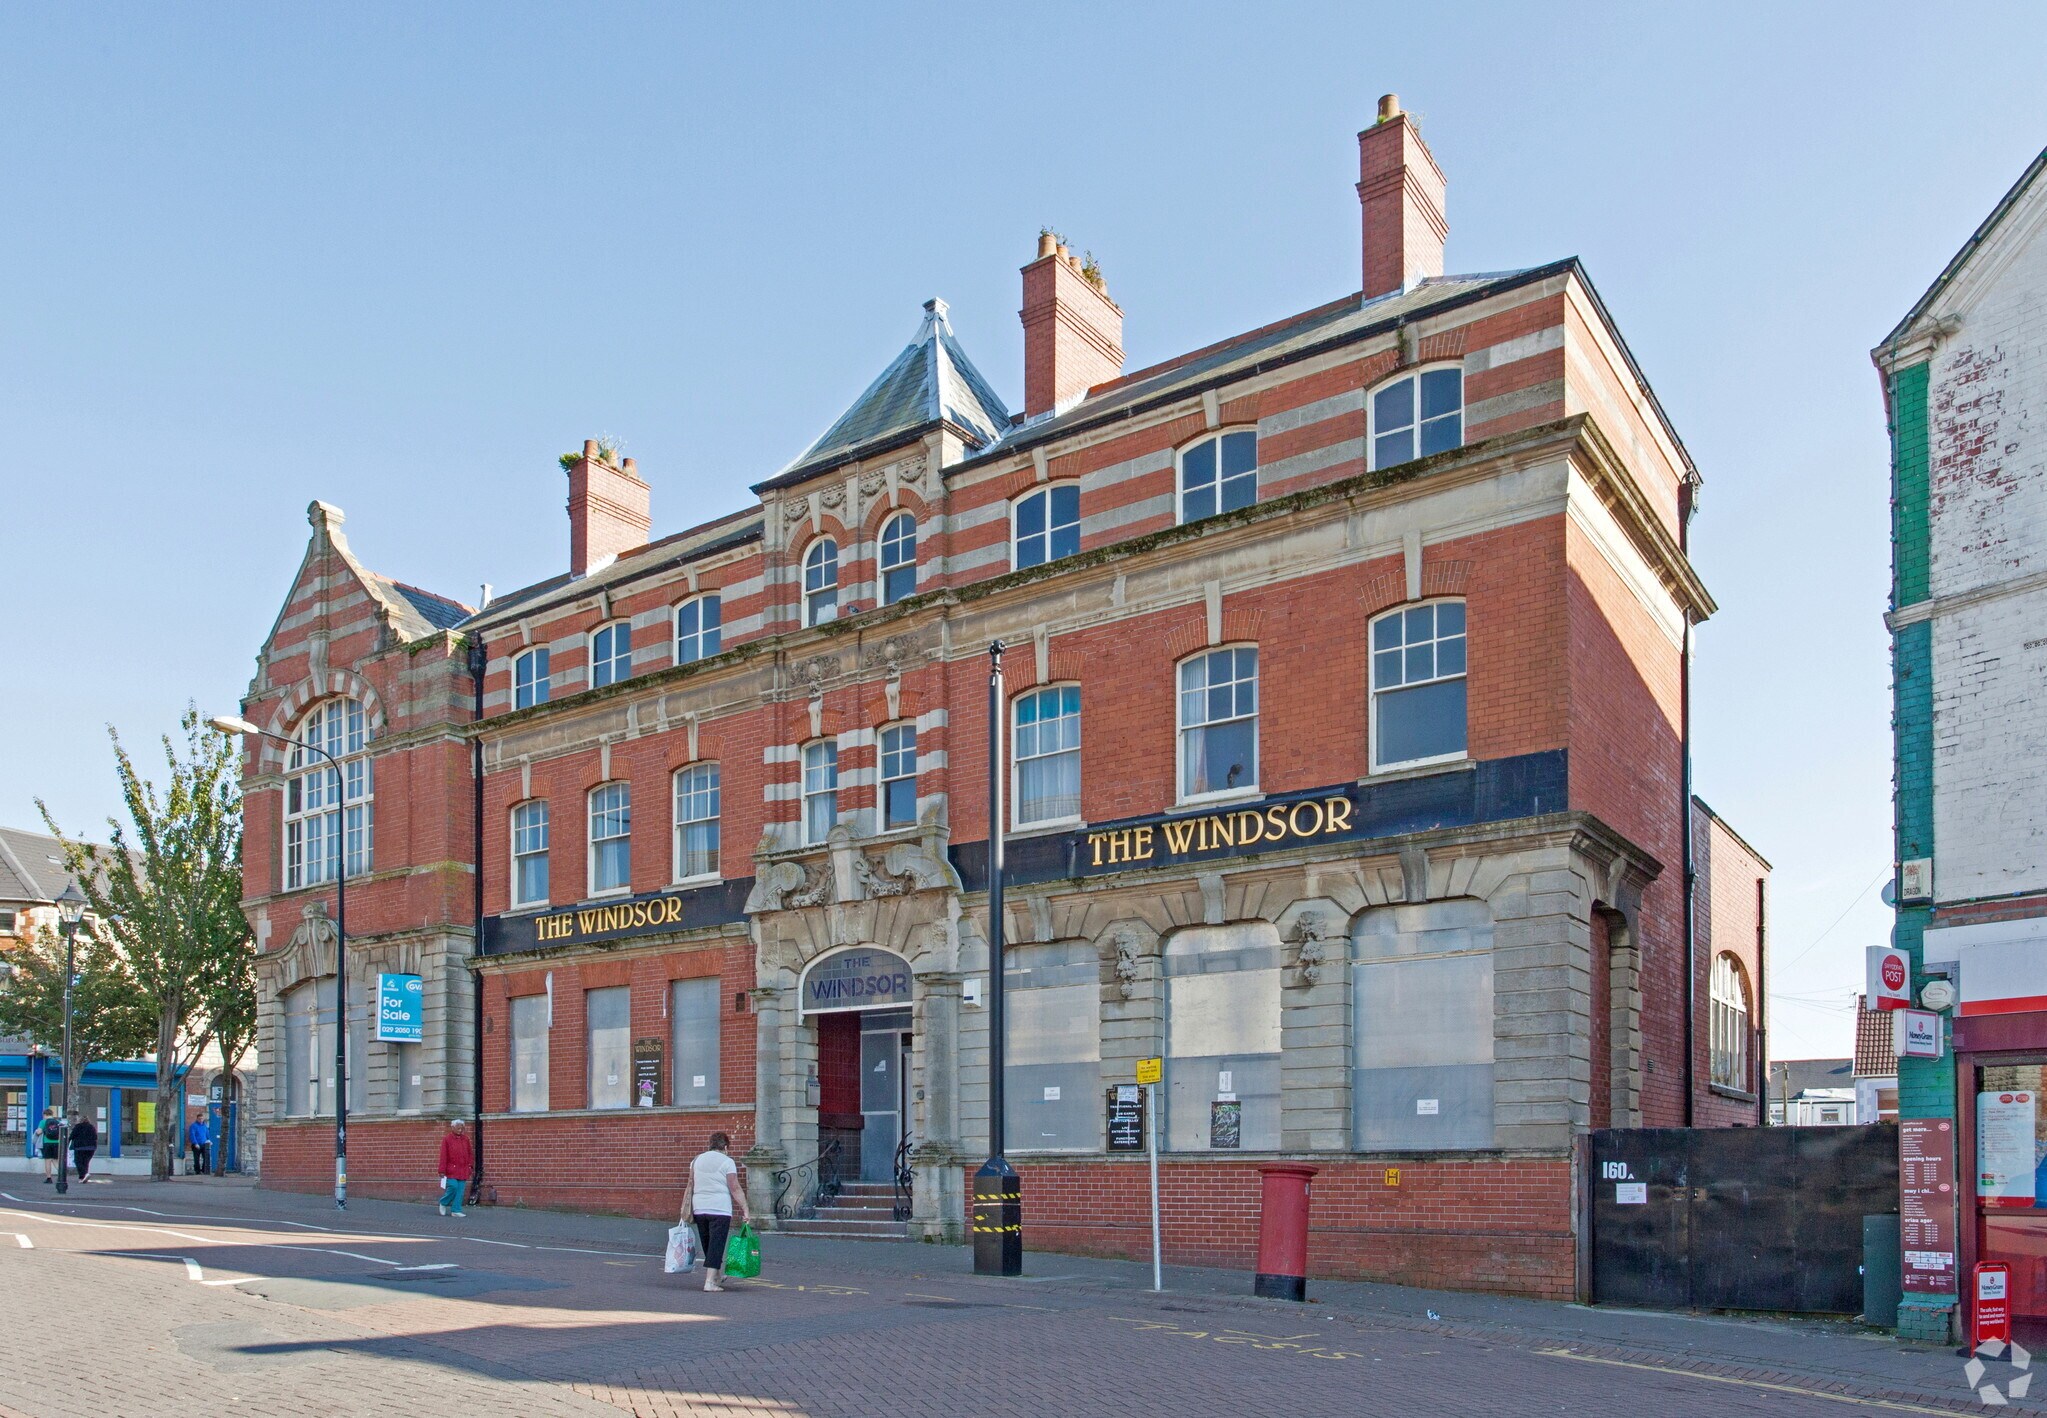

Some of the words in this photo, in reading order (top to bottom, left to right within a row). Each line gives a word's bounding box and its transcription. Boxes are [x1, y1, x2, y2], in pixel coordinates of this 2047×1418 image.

[1088, 826, 1154, 866] THE
[1162, 796, 1352, 855] WINDSOR
[535, 912, 574, 941] THE
[577, 896, 682, 935] WINDSOR
[844, 956, 871, 968] THE
[1885, 970, 1902, 983] POST
[811, 973, 907, 999] WINDSOR
[383, 996, 403, 1008] For
[382, 1009, 411, 1021] Sale
[635, 1045, 662, 1053] WINDSOR
